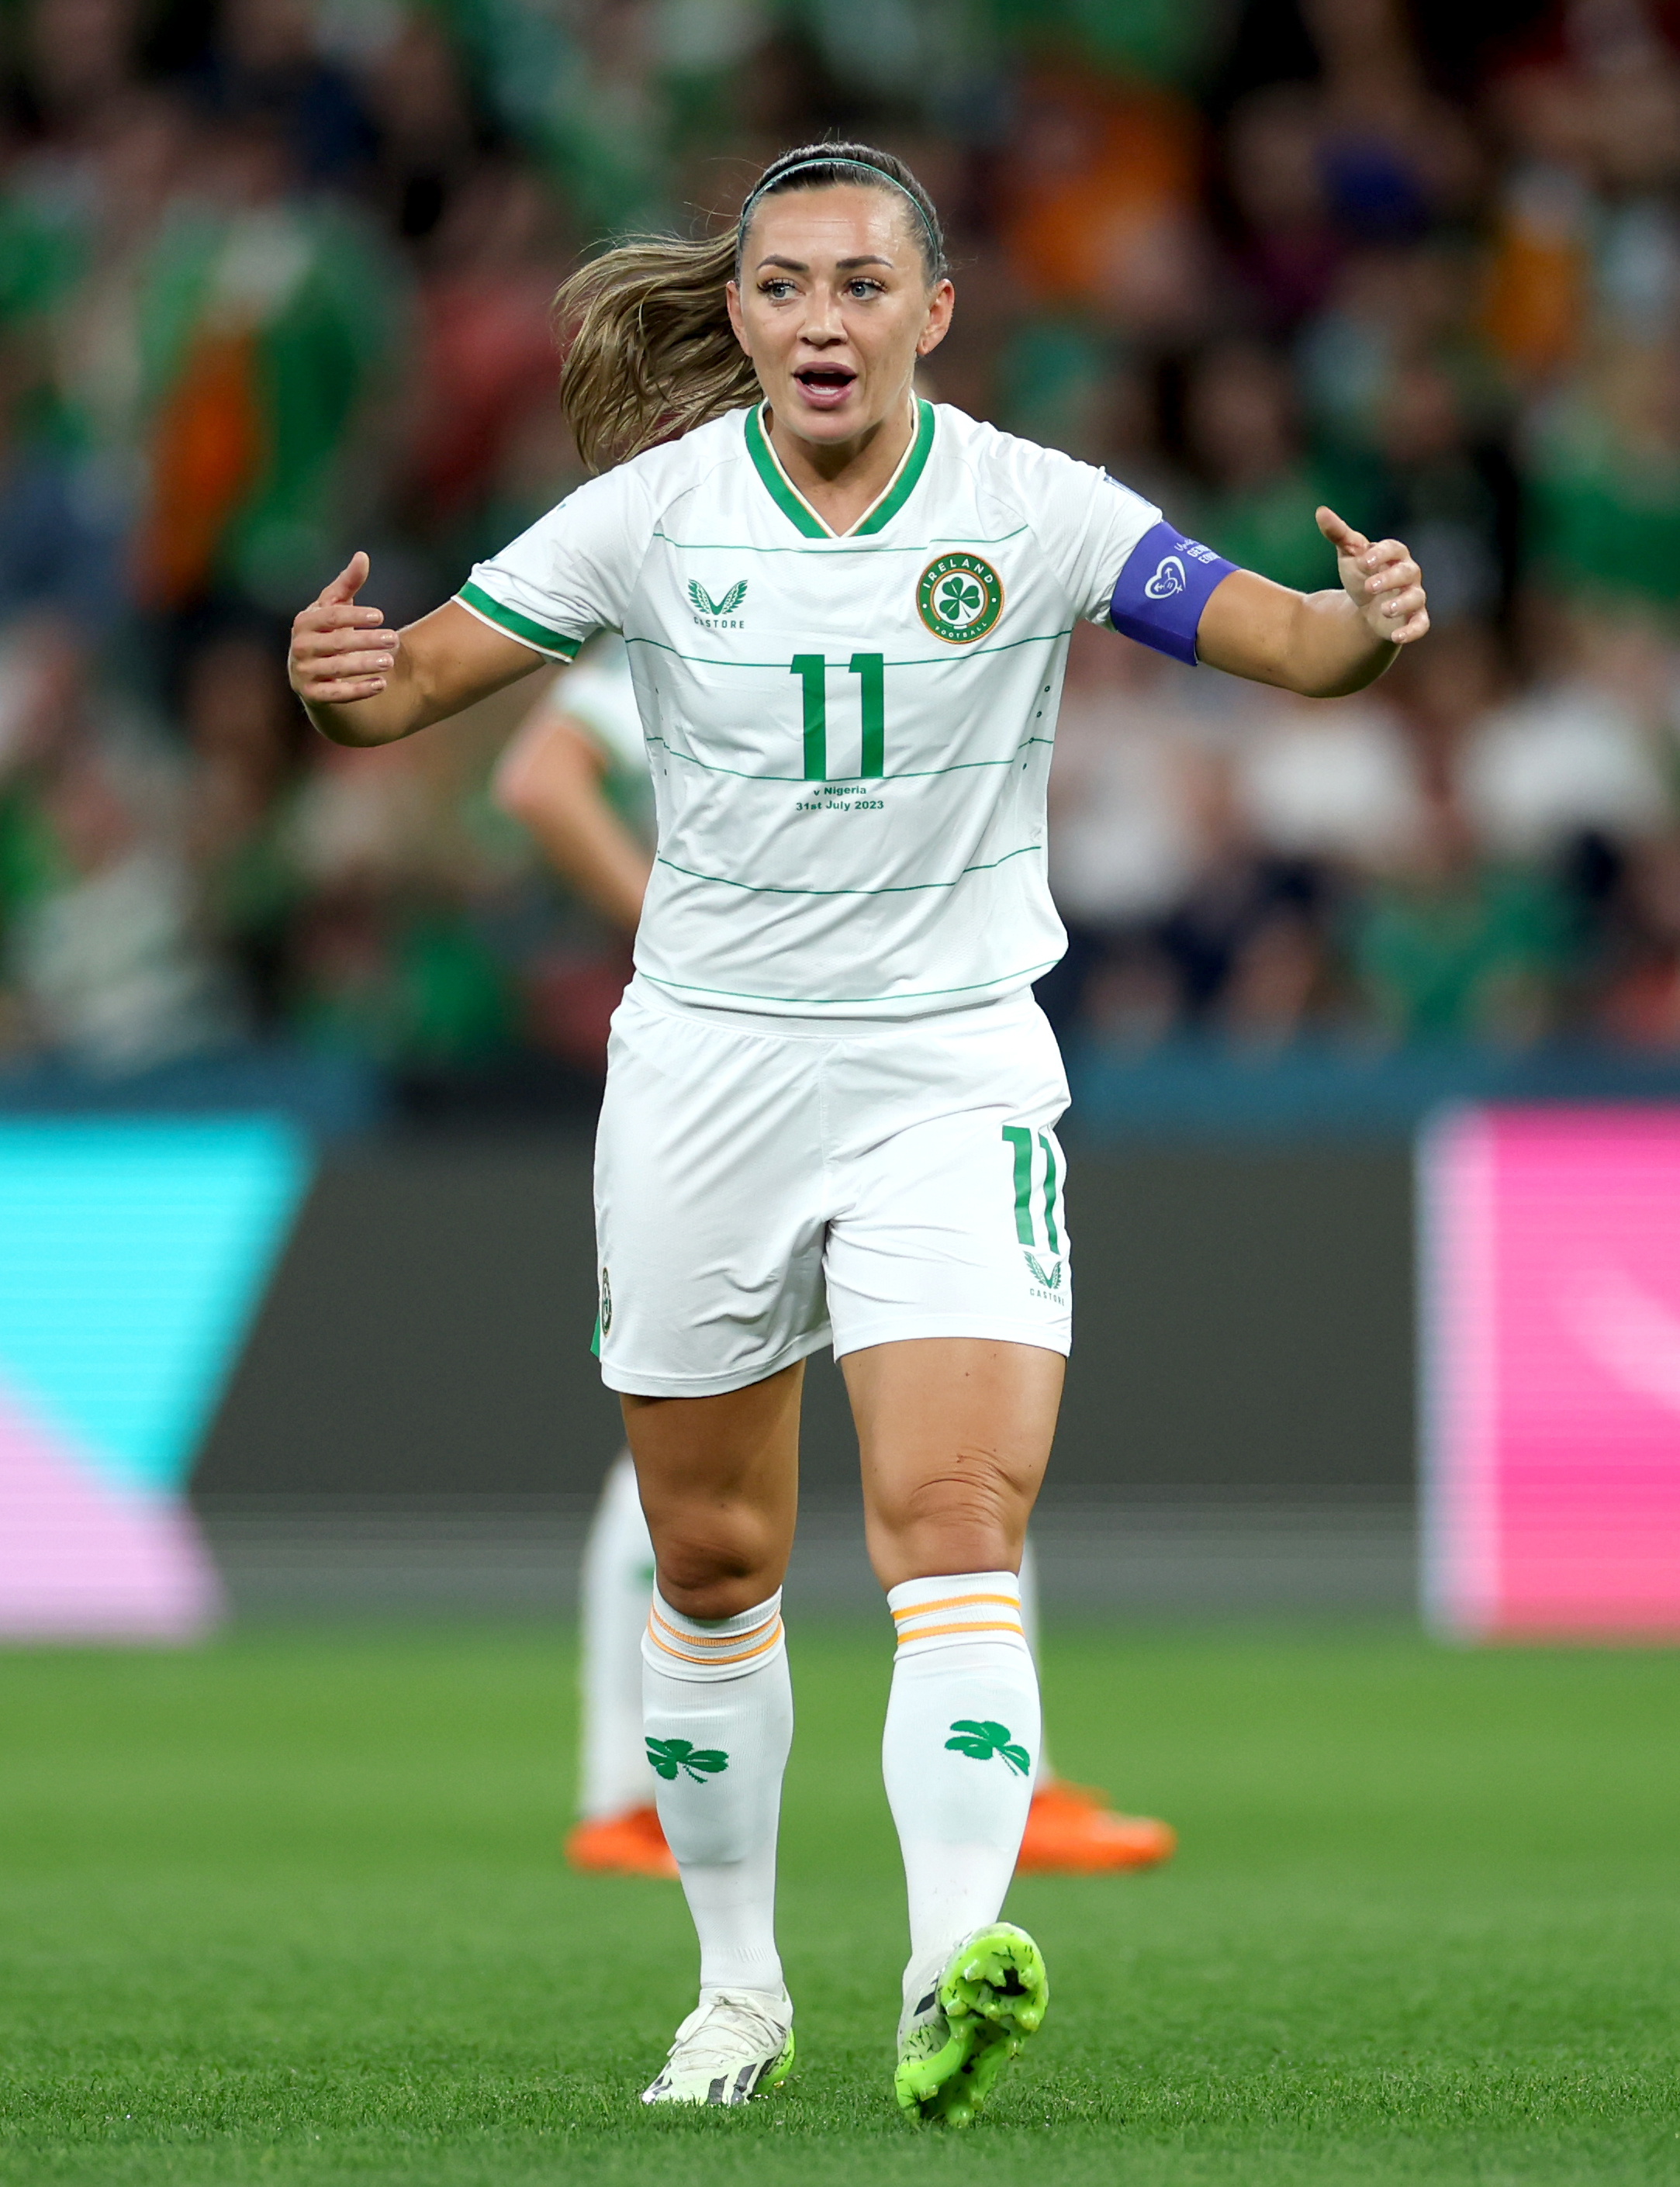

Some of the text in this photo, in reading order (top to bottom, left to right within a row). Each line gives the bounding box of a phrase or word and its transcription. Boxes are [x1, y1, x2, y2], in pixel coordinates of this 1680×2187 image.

[922, 558, 994, 589] IRELAND
[693, 617, 745, 629] CASTORE
[935, 622, 987, 639] FOOTBALL
[790, 653, 884, 781] 11
[824, 786, 867, 796] Nigeria
[796, 800, 884, 812] 31st July 2023
[1001, 1125, 1061, 1256] 11
